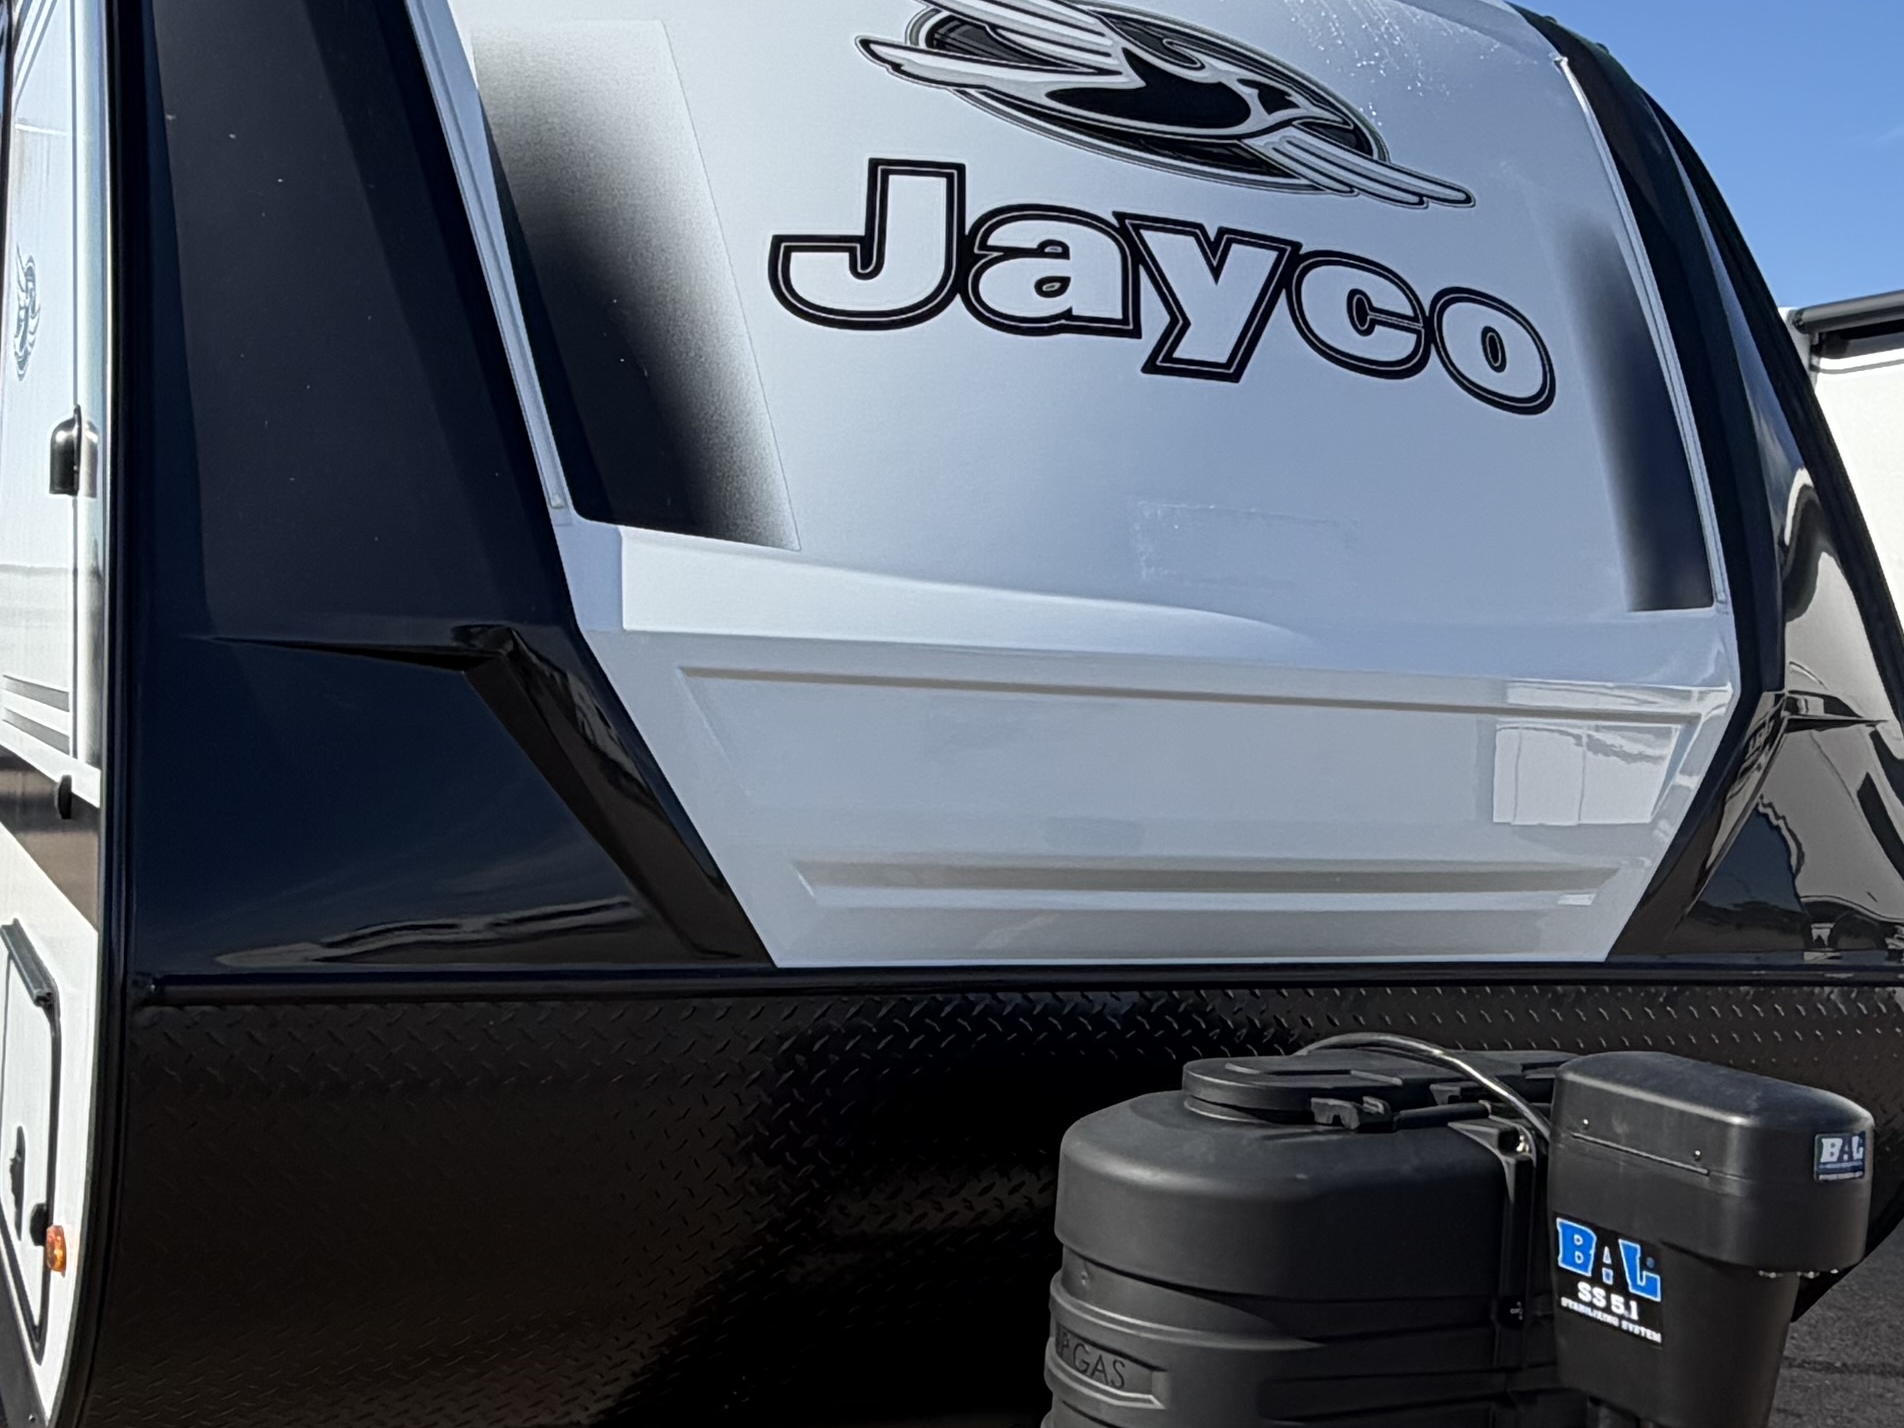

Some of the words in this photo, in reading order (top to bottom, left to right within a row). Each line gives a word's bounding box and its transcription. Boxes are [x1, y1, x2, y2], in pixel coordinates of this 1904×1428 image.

[770, 158, 1557, 415] Jayco
[1820, 1135, 1865, 1164] BAL
[1556, 1217, 1662, 1302] BAL
[1577, 1280, 1607, 1309] SS
[1610, 1292, 1639, 1321] 5.1
[1620, 1319, 1662, 1344] SYSTEM
[1072, 1341, 1126, 1390] GAS
